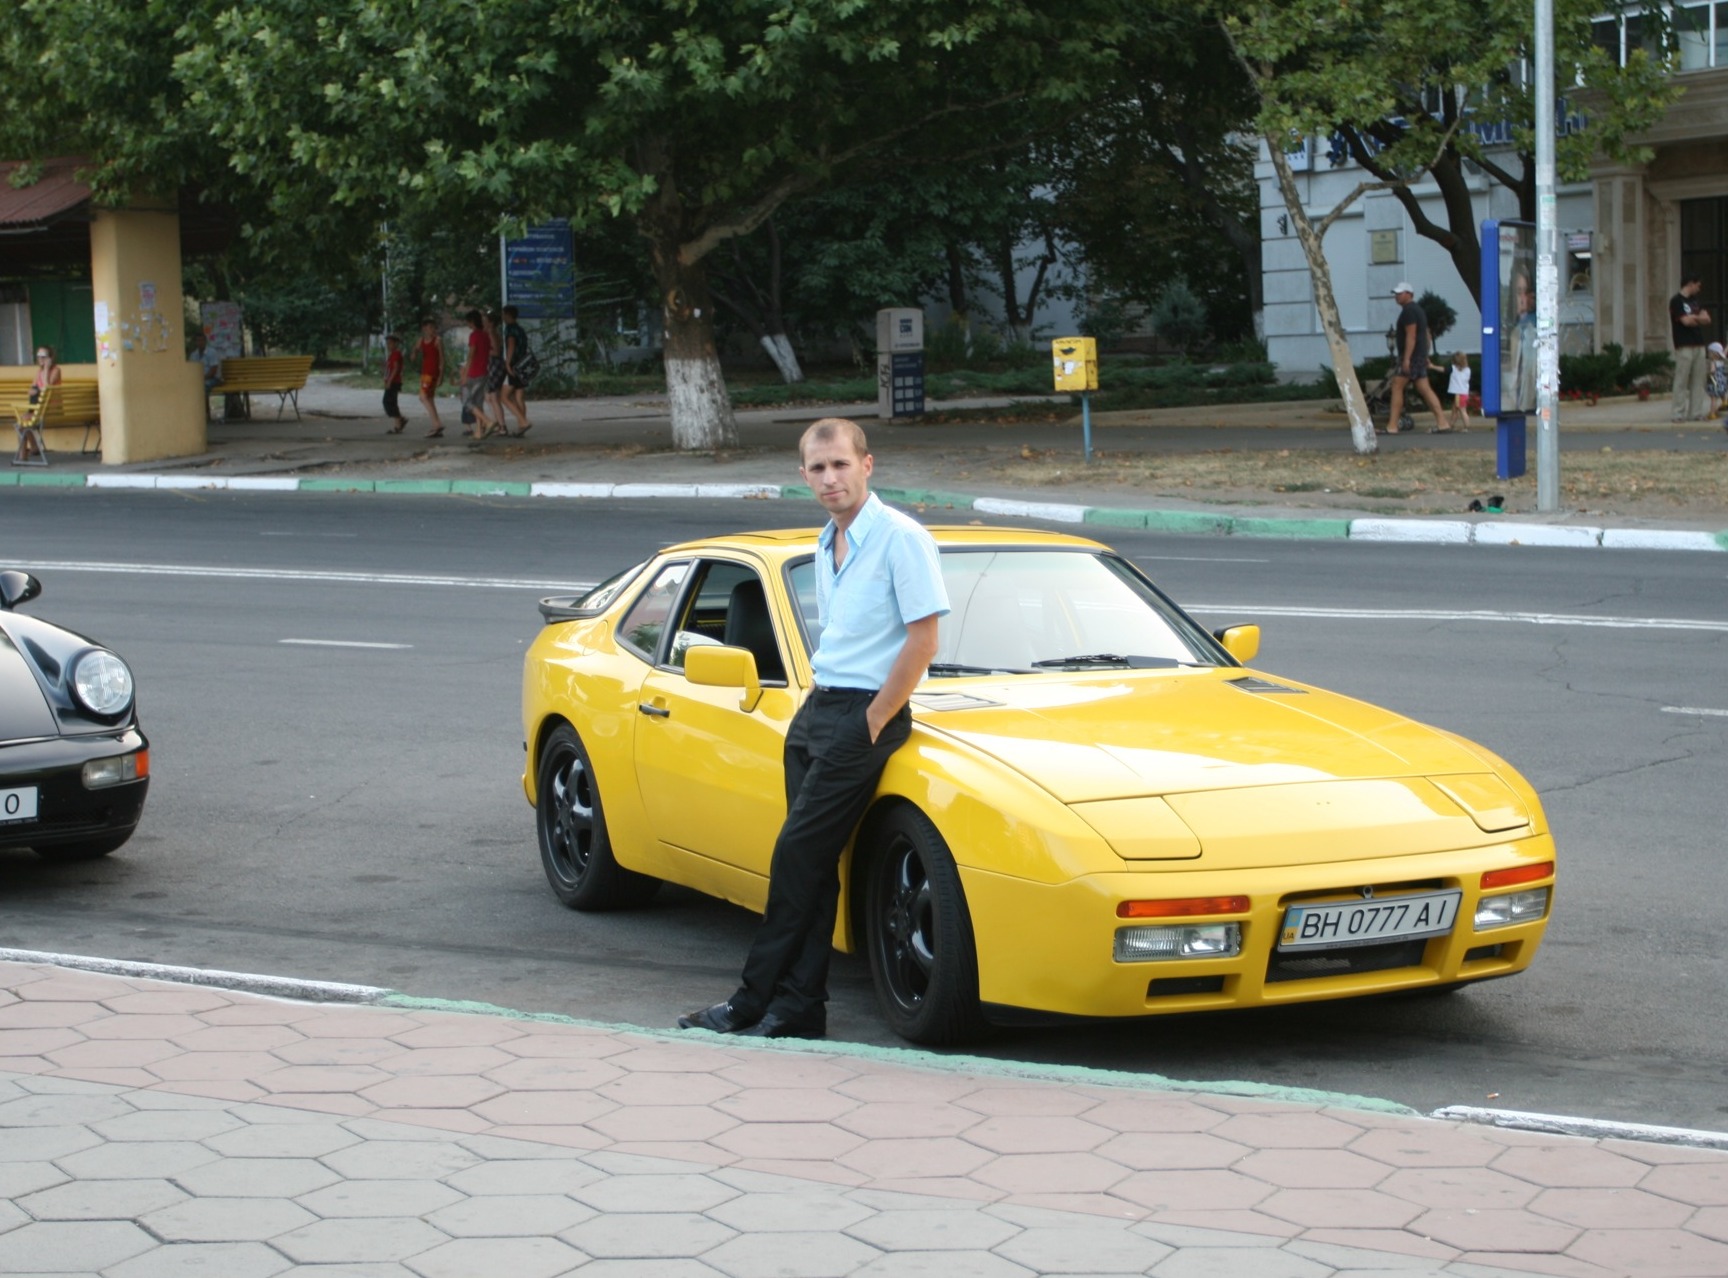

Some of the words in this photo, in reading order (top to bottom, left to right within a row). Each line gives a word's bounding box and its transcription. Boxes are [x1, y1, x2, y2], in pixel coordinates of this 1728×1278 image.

[1300, 911, 1342, 939] BH
[1348, 904, 1408, 934] 0777
[1282, 932, 1295, 940] UA
